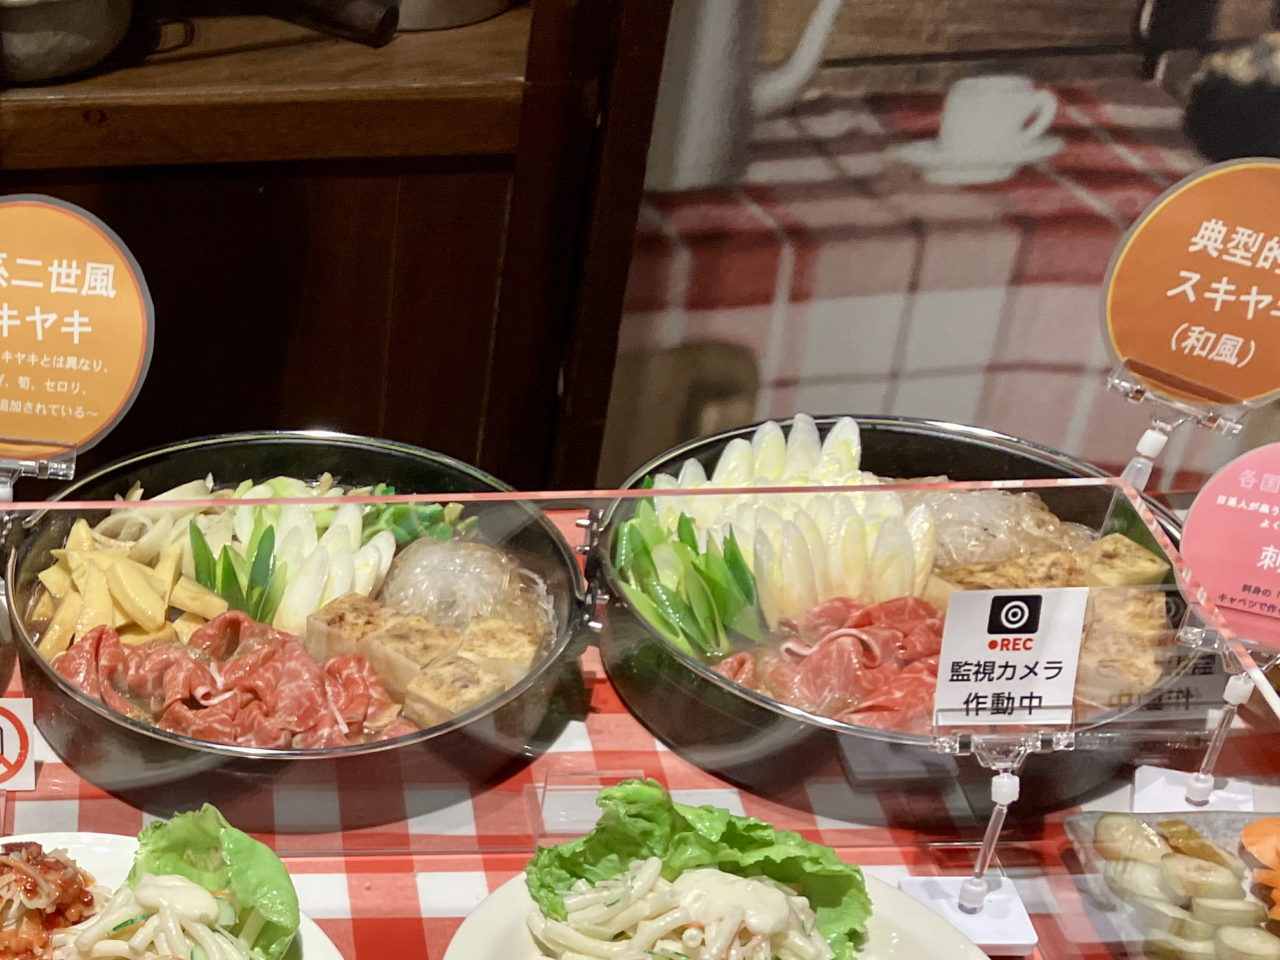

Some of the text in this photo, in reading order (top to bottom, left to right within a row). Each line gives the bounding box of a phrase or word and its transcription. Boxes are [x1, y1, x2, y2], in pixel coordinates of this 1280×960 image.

[1188, 218, 1280, 275] 典型的
[1166, 269, 1280, 320] スキヤ
[999, 637, 1034, 651] REC
[949, 660, 1063, 683] 監視カメラ
[963, 691, 1043, 717] 作動中
